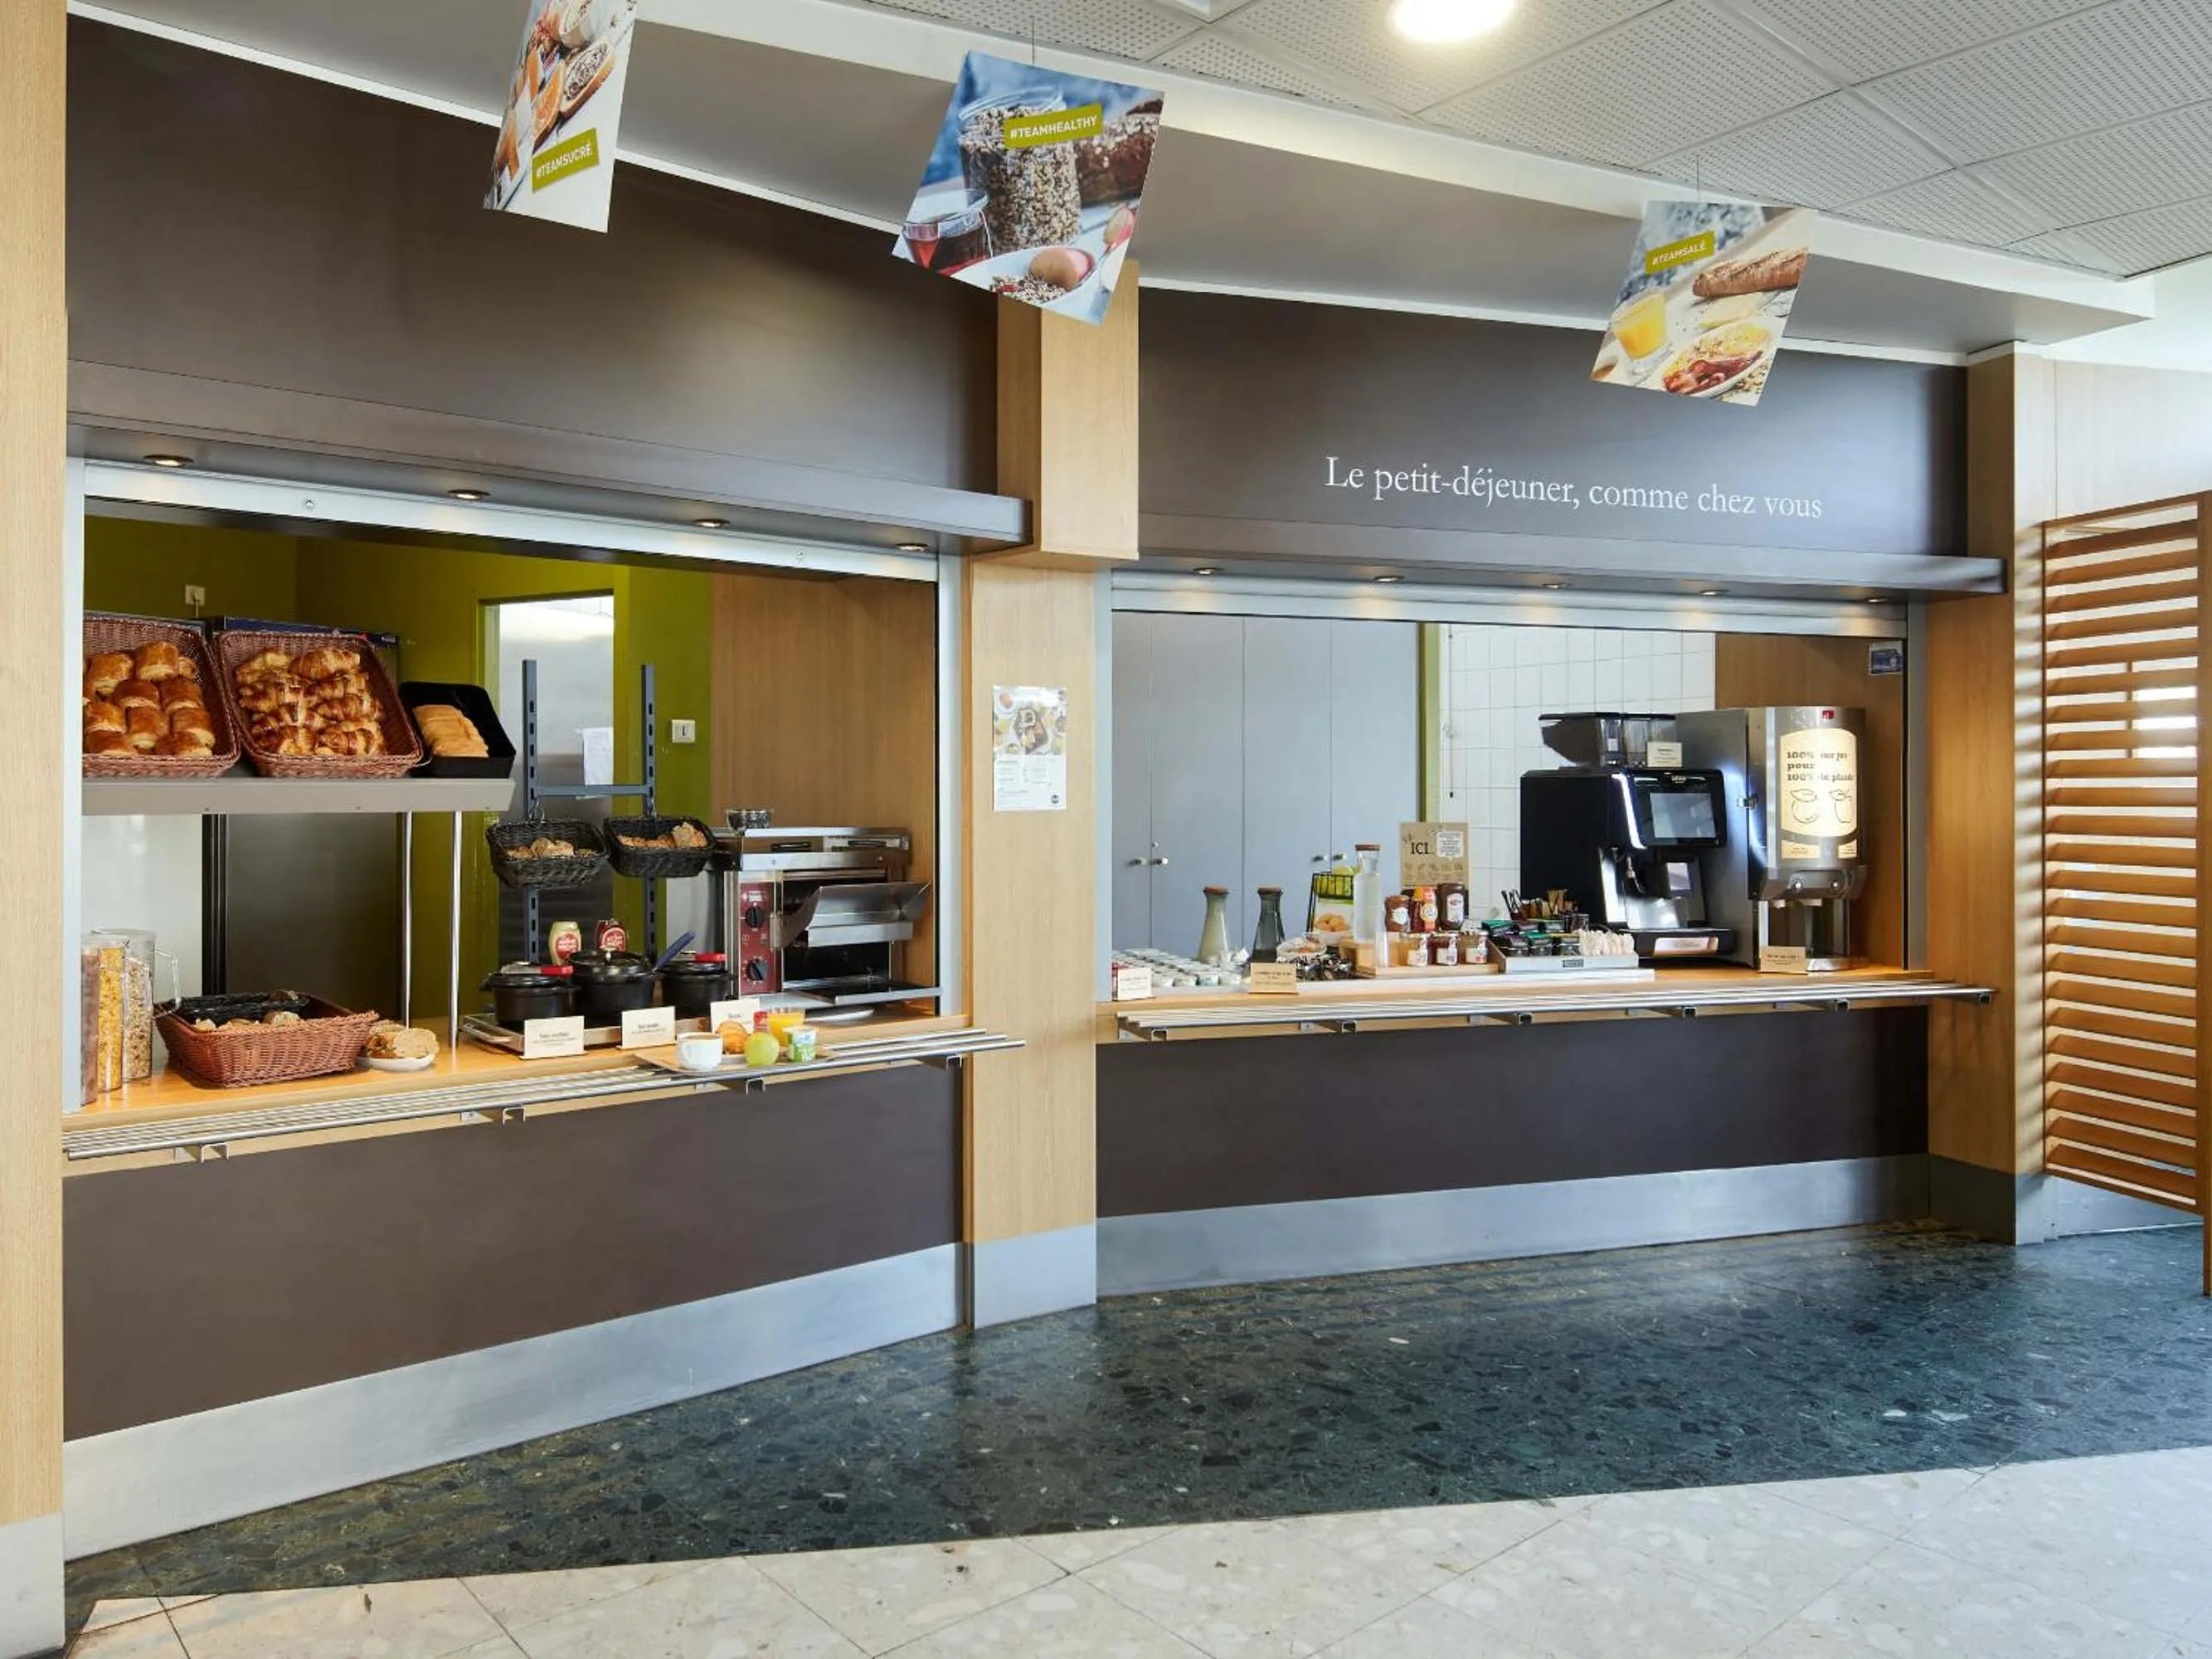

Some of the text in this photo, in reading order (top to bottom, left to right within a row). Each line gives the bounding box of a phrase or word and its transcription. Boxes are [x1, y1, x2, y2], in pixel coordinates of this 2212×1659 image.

[1010, 115, 1096, 139] #TEAMHEALTHY
[536, 139, 592, 179] #TEAMSUCRÉ
[1652, 239, 1706, 265] #TEAMSALÉ
[1325, 455, 1823, 518] Le petit-déjeuner, comme chez vous
[1787, 762, 1815, 772] pour
